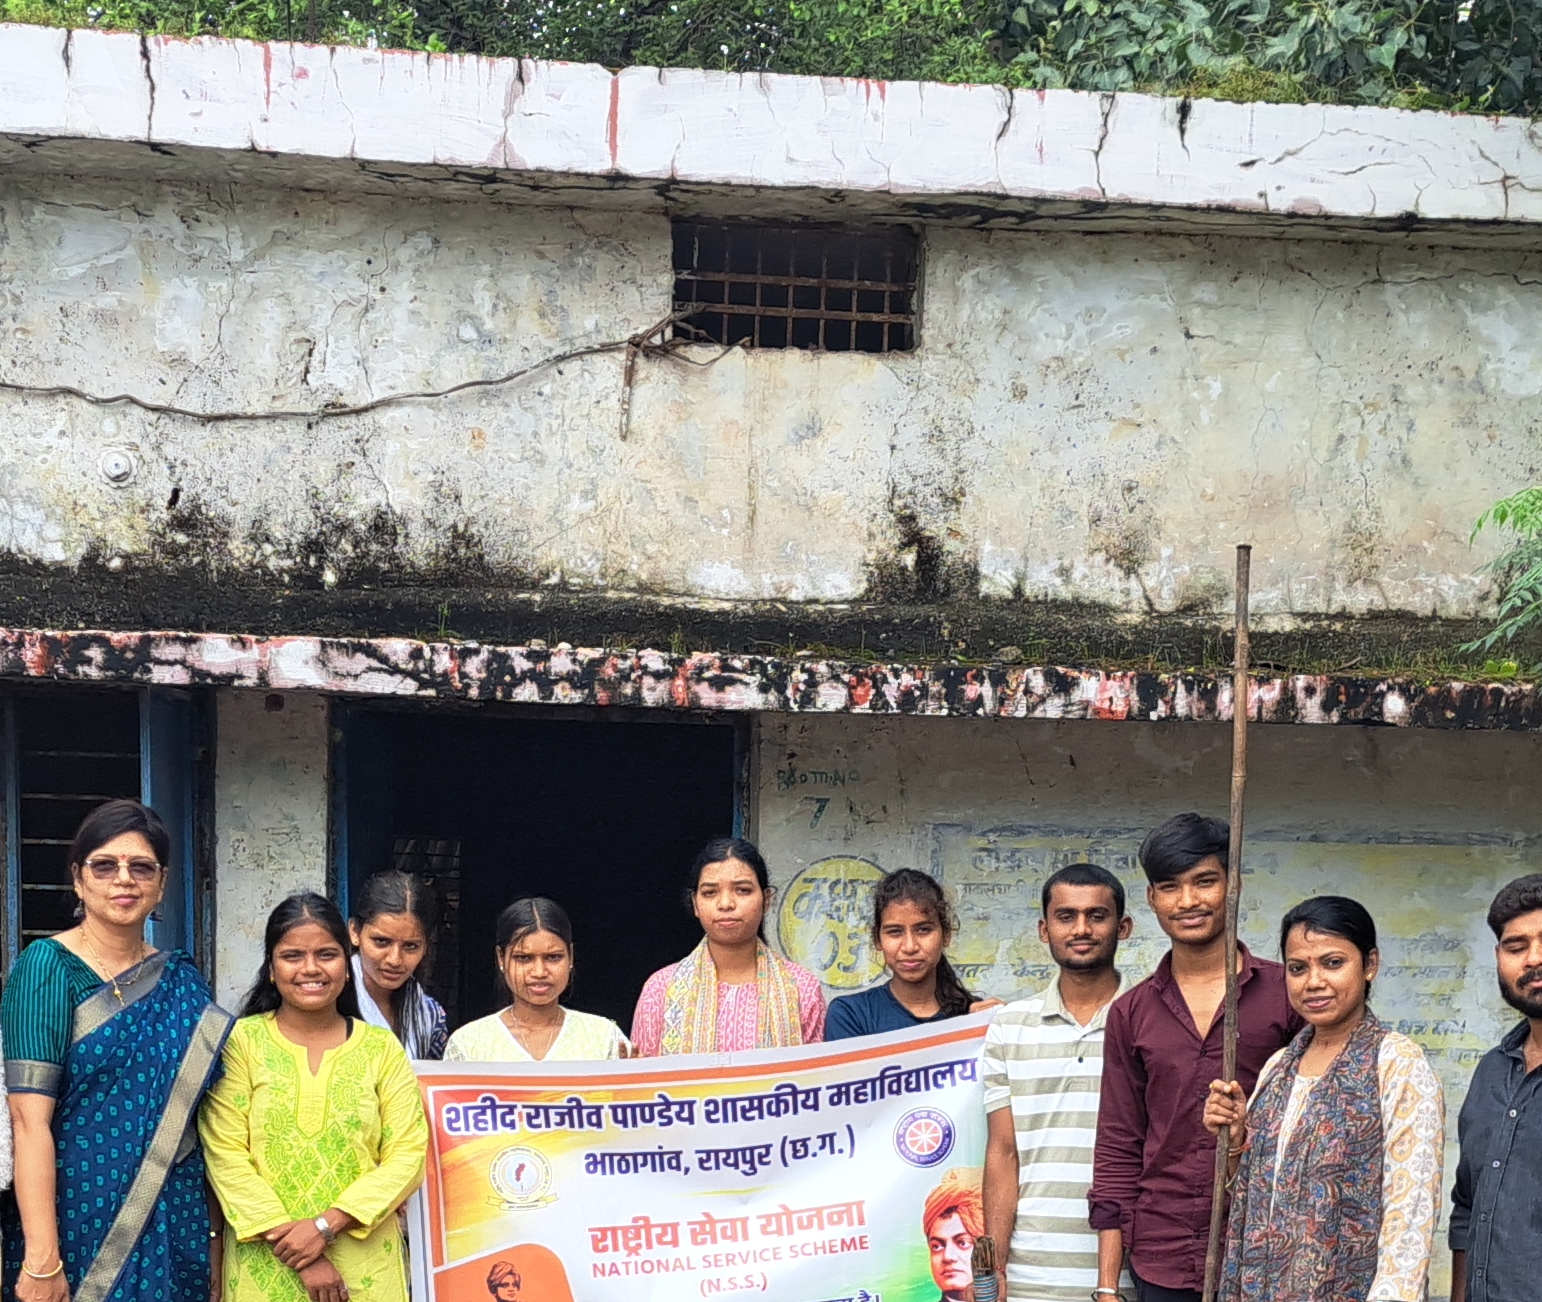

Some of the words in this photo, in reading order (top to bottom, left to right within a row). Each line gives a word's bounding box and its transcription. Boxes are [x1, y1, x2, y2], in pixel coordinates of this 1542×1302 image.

[445, 1095, 519, 1133] शहीद
[522, 1096, 604, 1129] राजीव
[610, 1093, 696, 1129] पाण्डेय
[704, 1083, 822, 1125] शासकीय
[826, 1057, 980, 1108] महाविद्यालय
[584, 1145, 690, 1176] भाठागांव,
[697, 1143, 774, 1176] रायपुर
[780, 1124, 856, 1167] (छ.ग.)
[588, 1215, 680, 1258] राष्ट्रीय
[687, 1211, 750, 1246] सेवा
[756, 1199, 866, 1237] योजना
[591, 1256, 696, 1278] NATIONAL
[701, 1244, 783, 1269] SERVICE
[788, 1235, 870, 1259] SCHEME
[699, 1272, 768, 1297] (N.S.S.)
